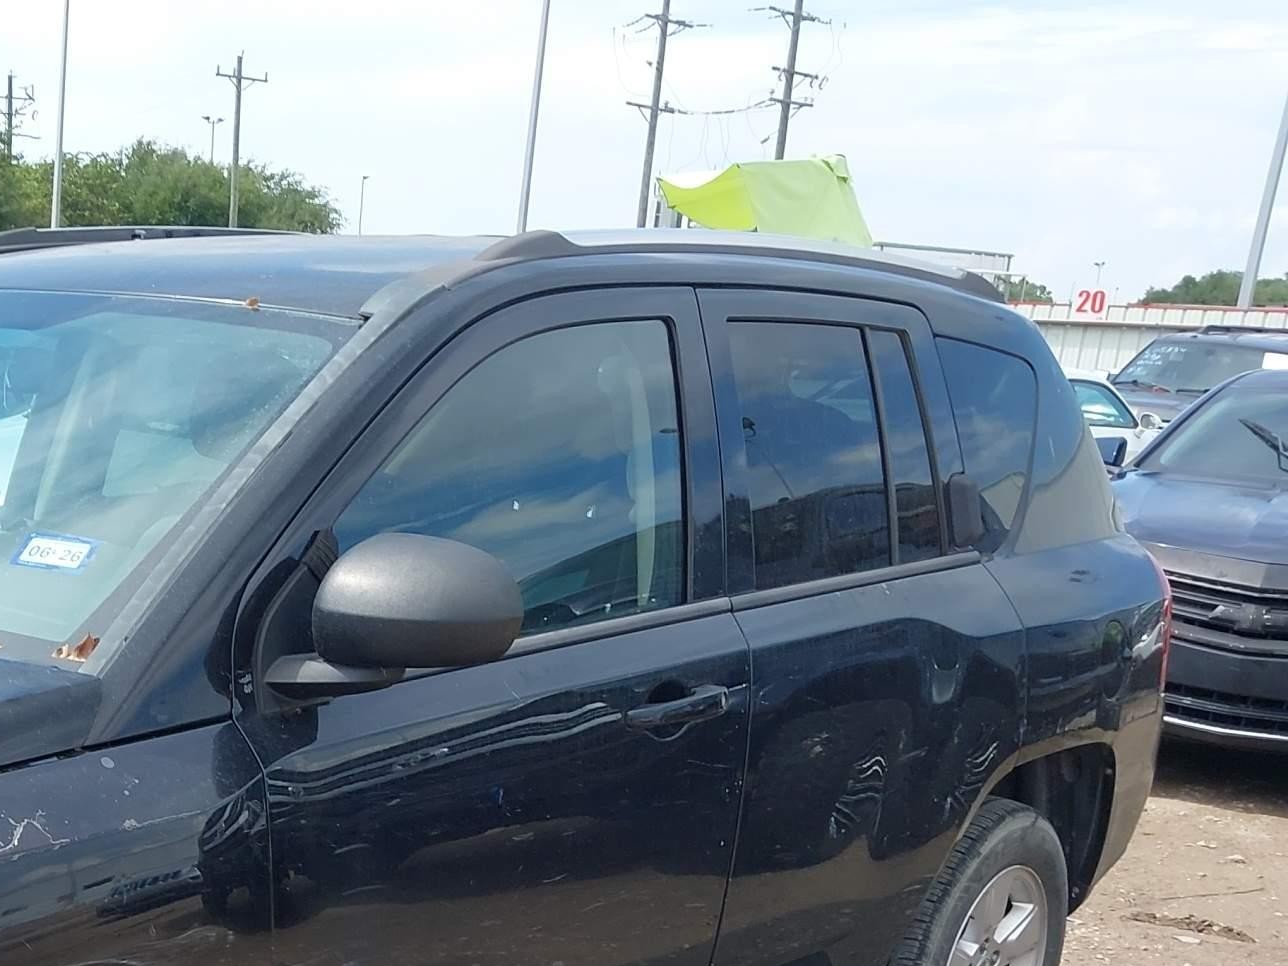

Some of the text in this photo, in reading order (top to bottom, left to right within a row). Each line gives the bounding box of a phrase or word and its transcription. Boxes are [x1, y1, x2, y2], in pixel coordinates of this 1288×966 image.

[1075, 290, 1106, 313] 20
[28, 545, 83, 563] 06 26
